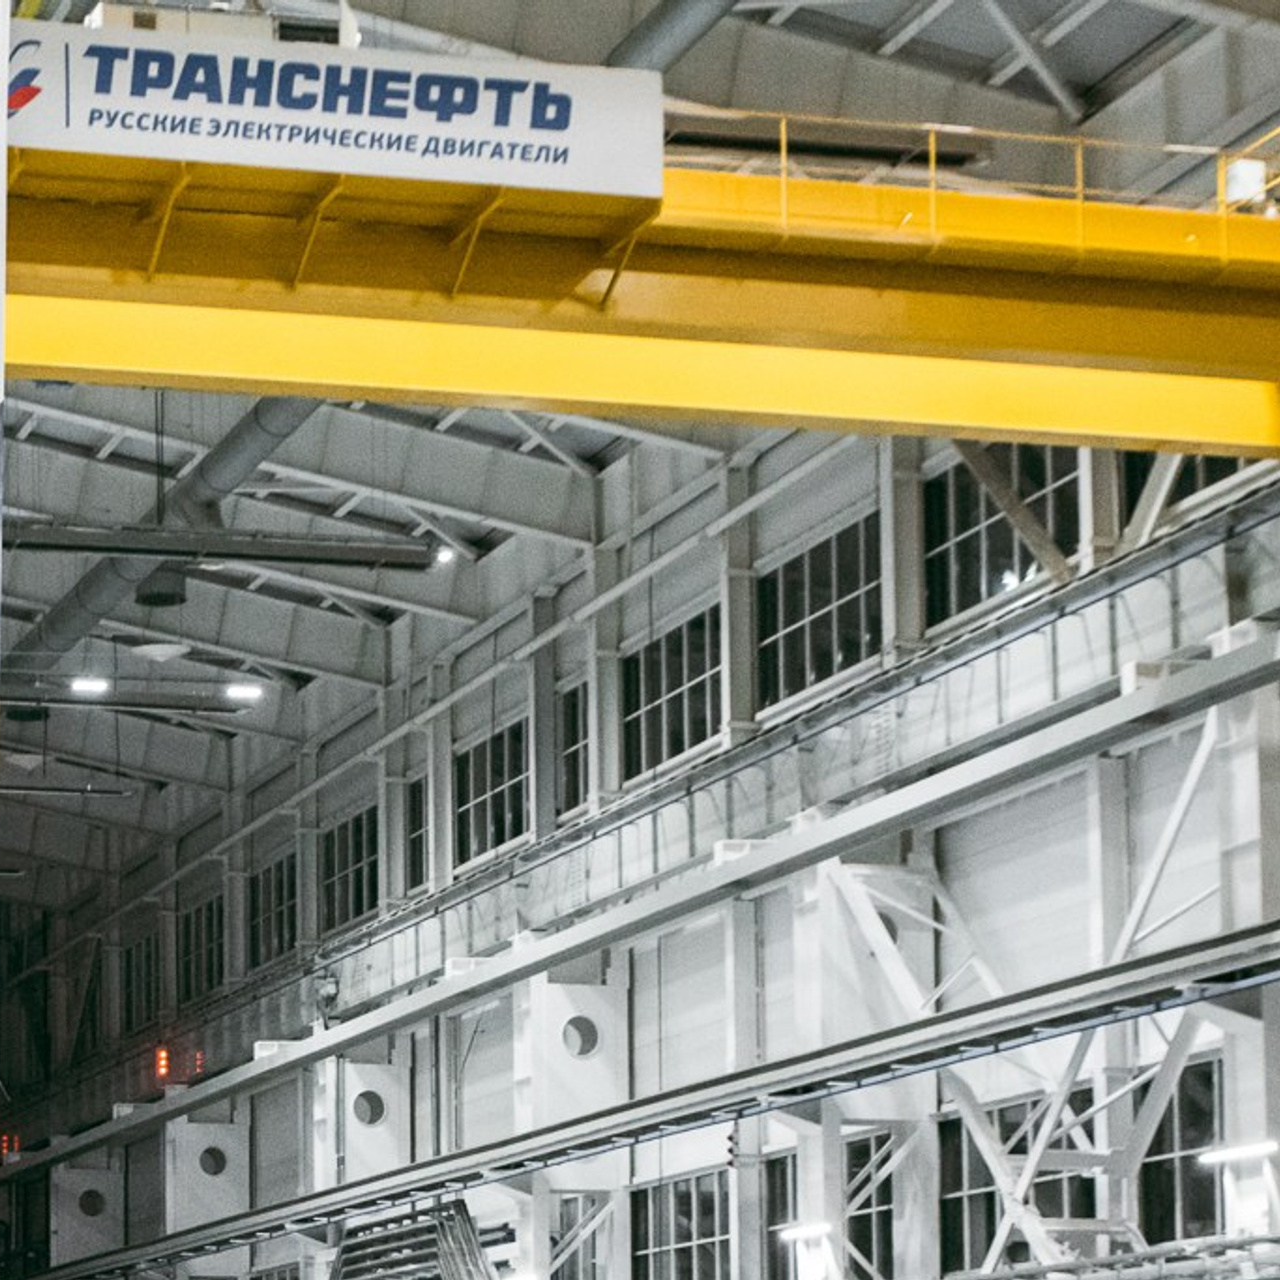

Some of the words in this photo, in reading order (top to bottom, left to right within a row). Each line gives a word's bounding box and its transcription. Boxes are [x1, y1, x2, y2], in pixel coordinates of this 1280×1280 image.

[83, 44, 573, 131] ТРАНСНЕФТЬ
[88, 108, 203, 136] РУССКИЕ
[207, 118, 419, 152] ЭЛЕКТРИЧЕСКИЕ
[421, 136, 569, 164] ДВИГАТЕЛИ
